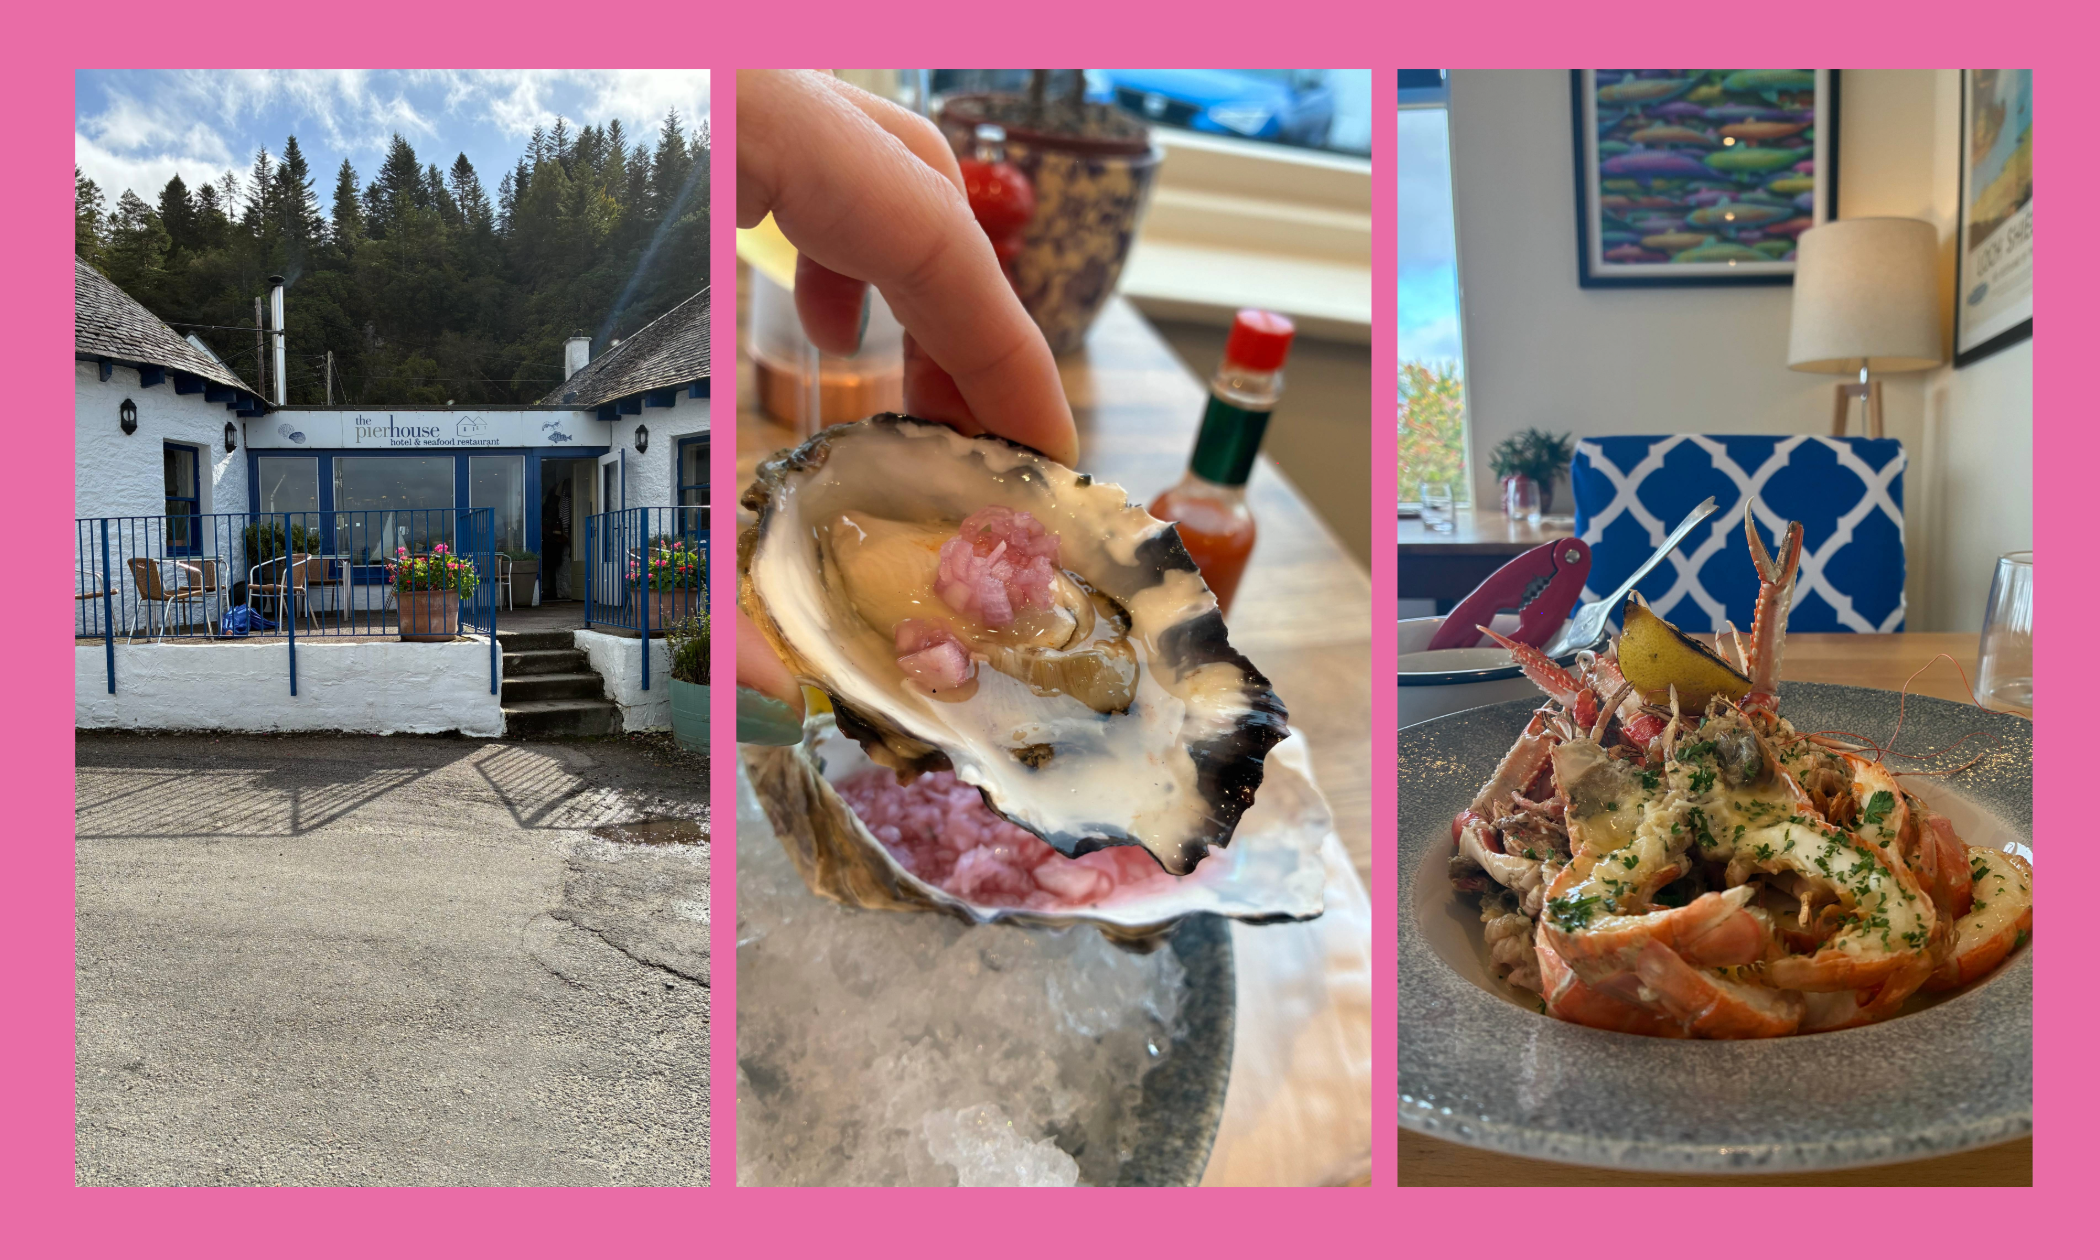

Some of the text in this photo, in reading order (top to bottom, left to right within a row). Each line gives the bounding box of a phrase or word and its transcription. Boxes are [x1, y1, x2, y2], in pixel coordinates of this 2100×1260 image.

[355, 414, 372, 426] the
[355, 414, 440, 443] pierhouse
[390, 438, 500, 446] hotel & seafood restaurant
